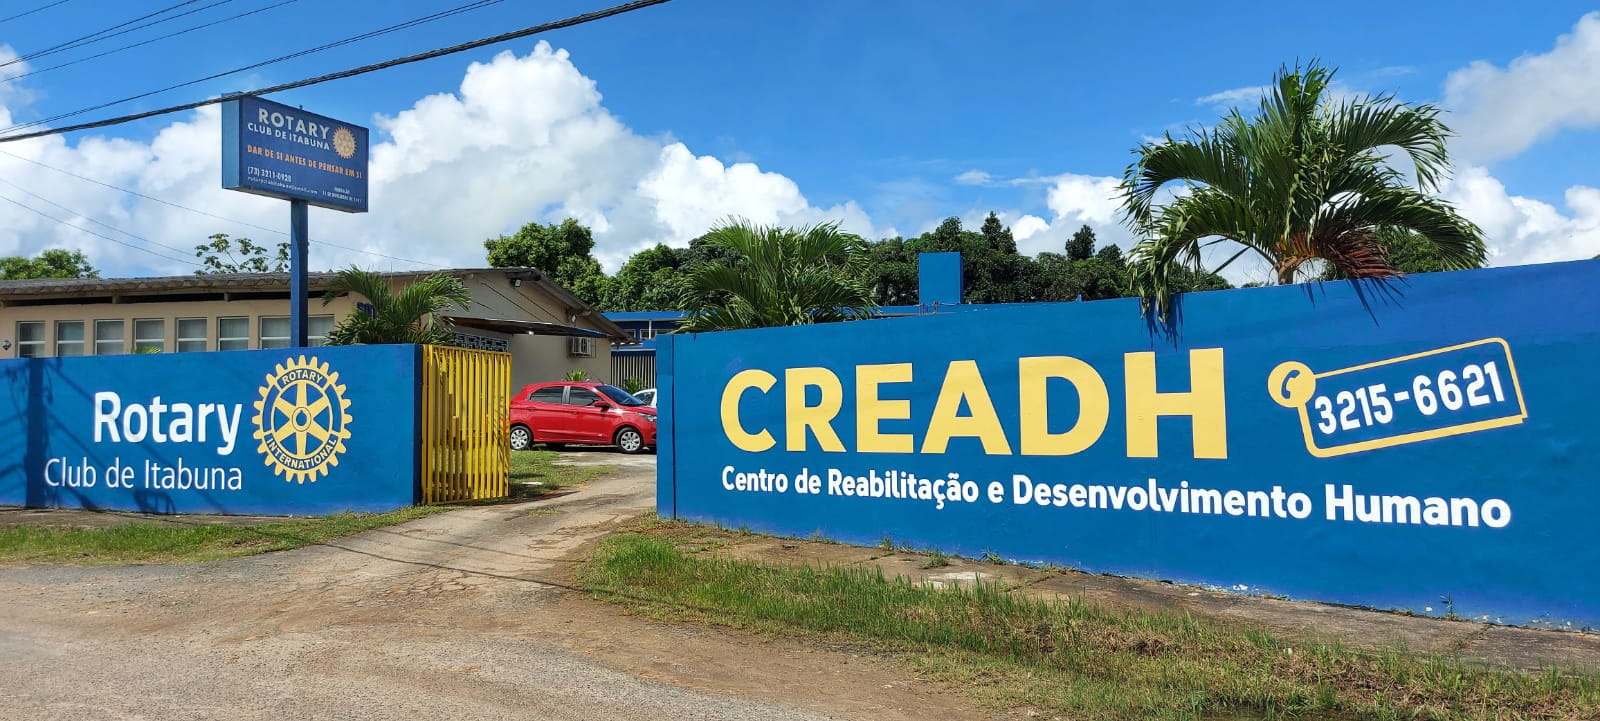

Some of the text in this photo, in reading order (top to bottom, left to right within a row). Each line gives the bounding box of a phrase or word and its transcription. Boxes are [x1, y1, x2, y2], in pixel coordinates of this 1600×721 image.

[247, 122, 330, 151] CLUB DE ITABUNA
[258, 107, 330, 140] ROTARY
[247, 144, 263, 156] DAR
[265, 148, 274, 159] DE
[276, 152, 283, 161] SI
[285, 153, 306, 166] ANTES
[308, 159, 317, 169] DE
[318, 162, 344, 174] PENSAR
[344, 168, 355, 177] EM
[247, 166, 260, 177] (73)
[281, 369, 323, 386] ROTARY
[720, 347, 1228, 459] CREADH
[1314, 360, 1506, 436] 3215-6621
[94, 391, 243, 456] Rotary
[266, 437, 337, 470] INTERNATIONAL
[44, 457, 243, 491] Club de Itabuna
[721, 465, 1512, 529] Centro de Reabilitação e Desenvolvimento Humano
